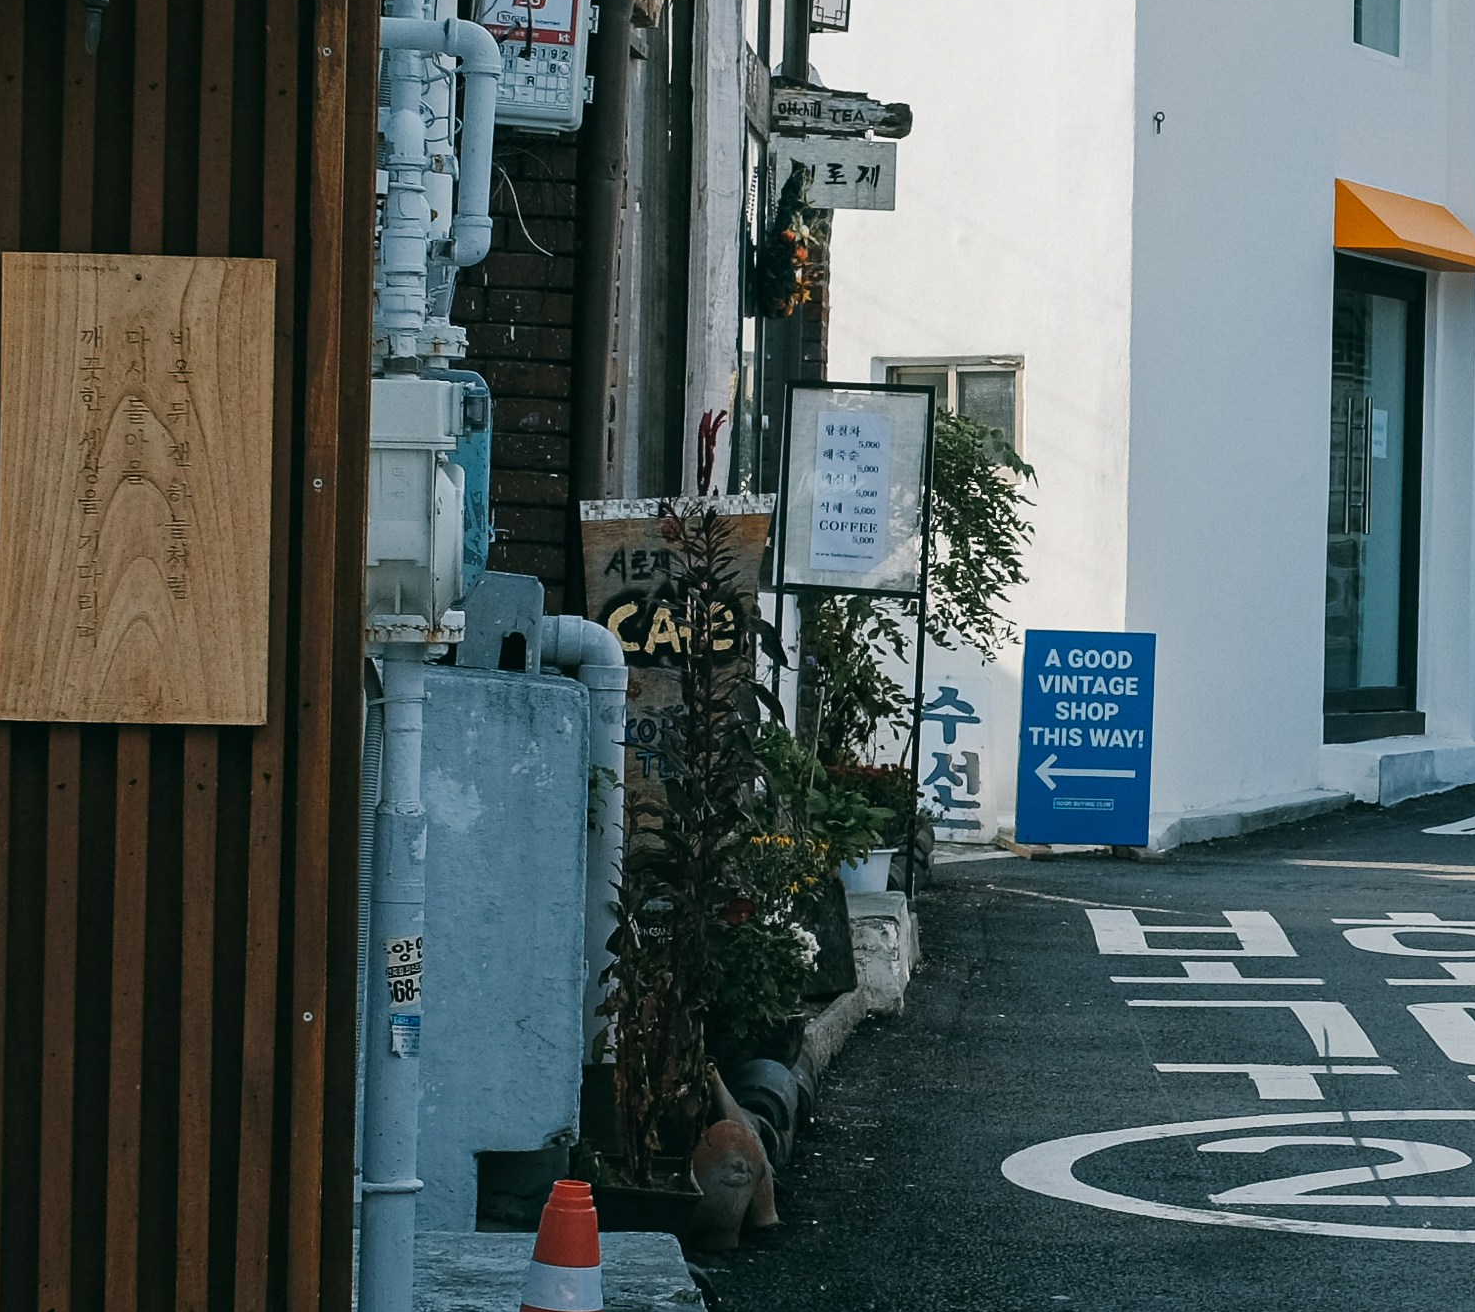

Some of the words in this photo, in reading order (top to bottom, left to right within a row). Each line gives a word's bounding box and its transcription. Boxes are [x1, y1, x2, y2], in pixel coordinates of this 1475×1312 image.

[828, 108, 867, 124] TEA
[818, 519, 878, 534] COFFEE
[1044, 648, 1062, 668] A
[1067, 650, 1133, 670] GOOD
[1037, 674, 1139, 697] VINTAGE
[1054, 701, 1120, 722] SHOP
[1028, 726, 1083, 748] THIS
[1089, 728, 1145, 749] WAY!
